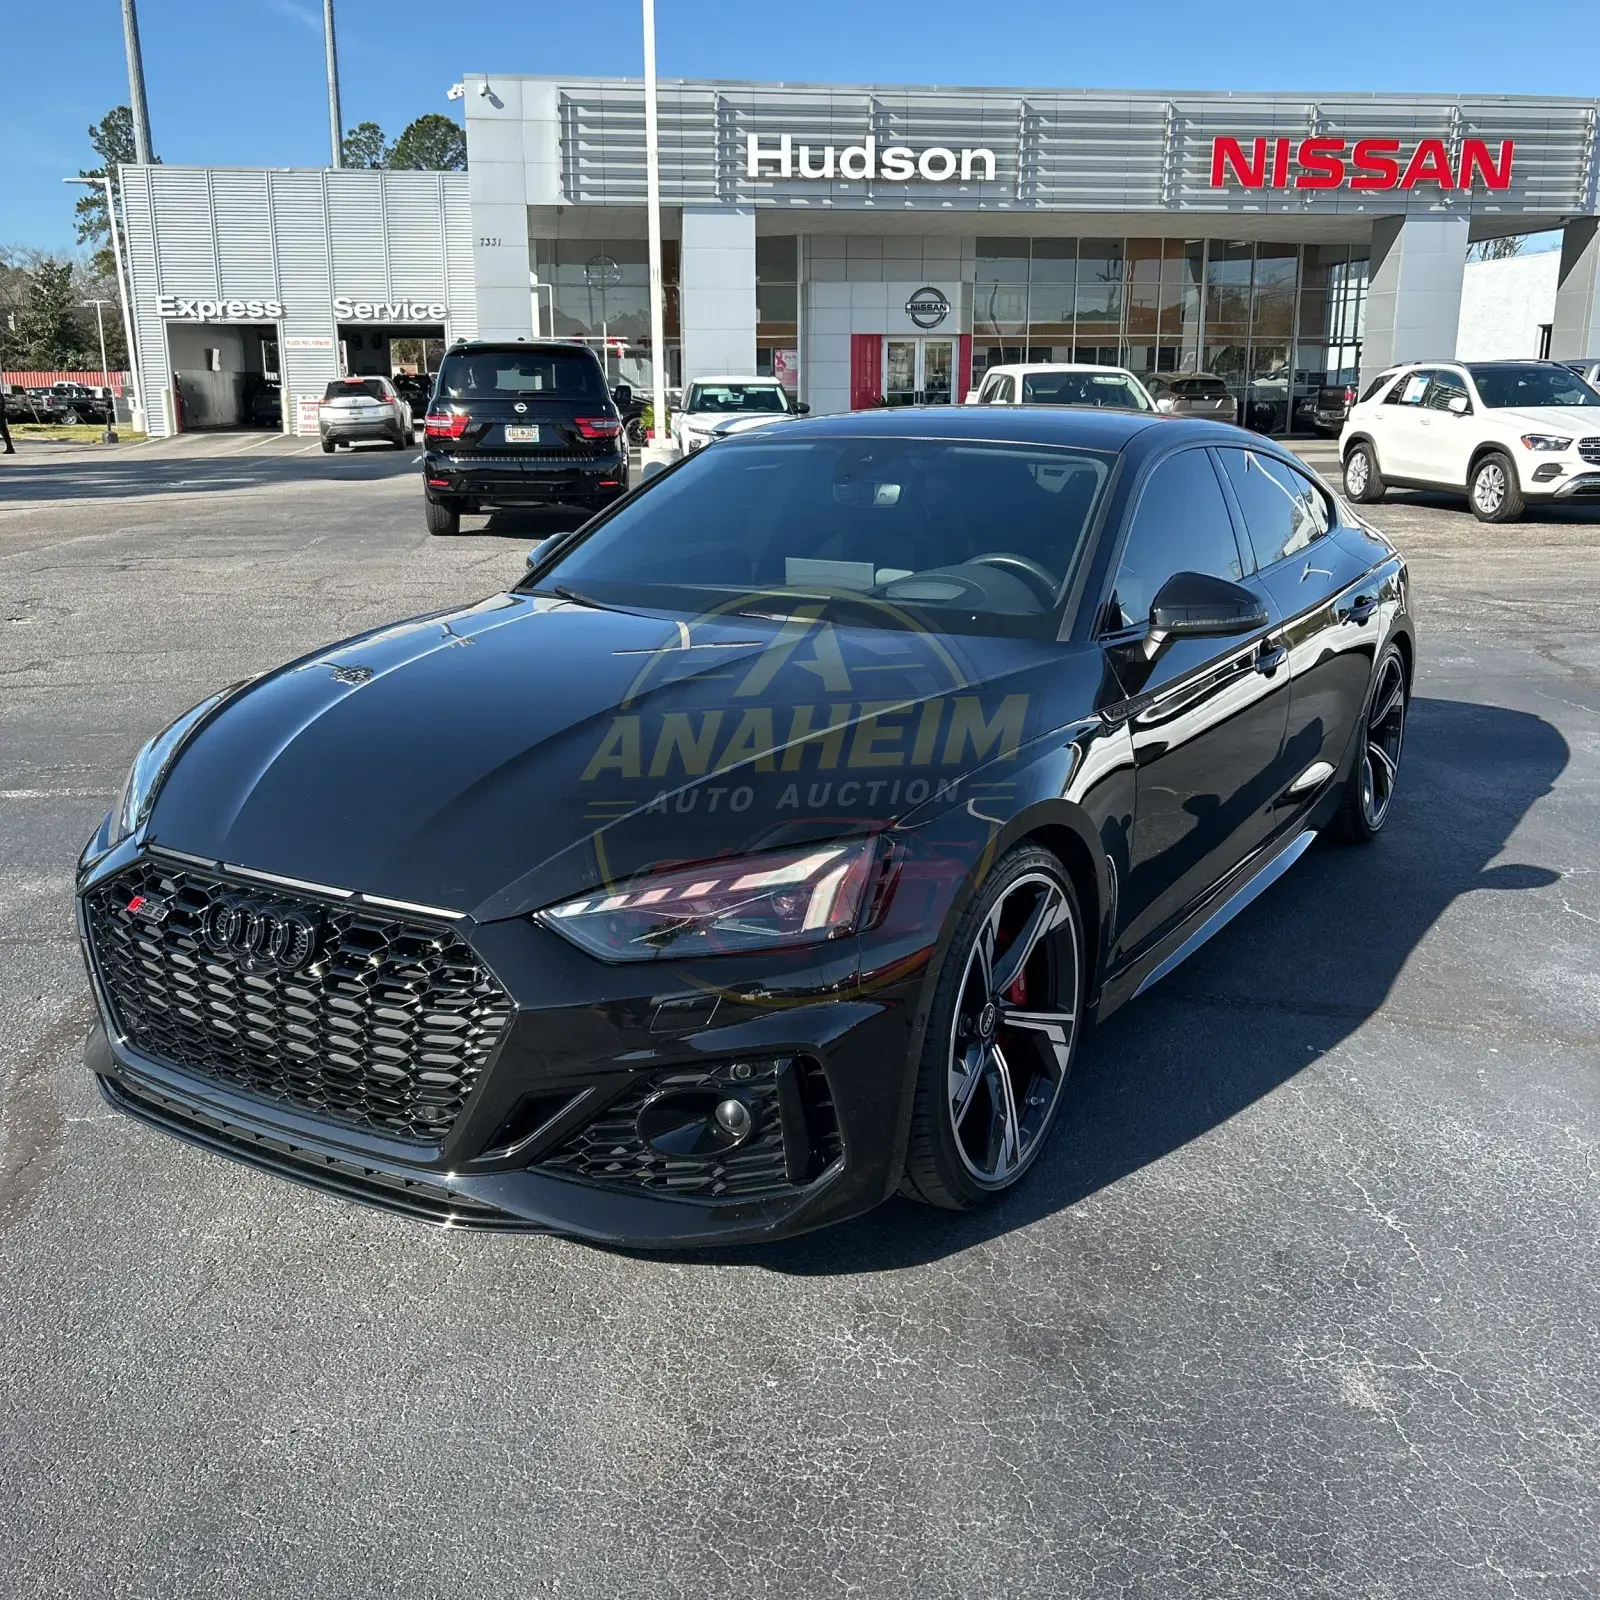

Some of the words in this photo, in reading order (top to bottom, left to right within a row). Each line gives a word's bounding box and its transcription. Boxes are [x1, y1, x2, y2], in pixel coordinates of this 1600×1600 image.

[746, 133, 996, 181] Hudson
[1209, 136, 1516, 191] NISSAN
[479, 237, 502, 247] 7331
[155, 295, 284, 322] Express
[332, 296, 448, 320] Service
